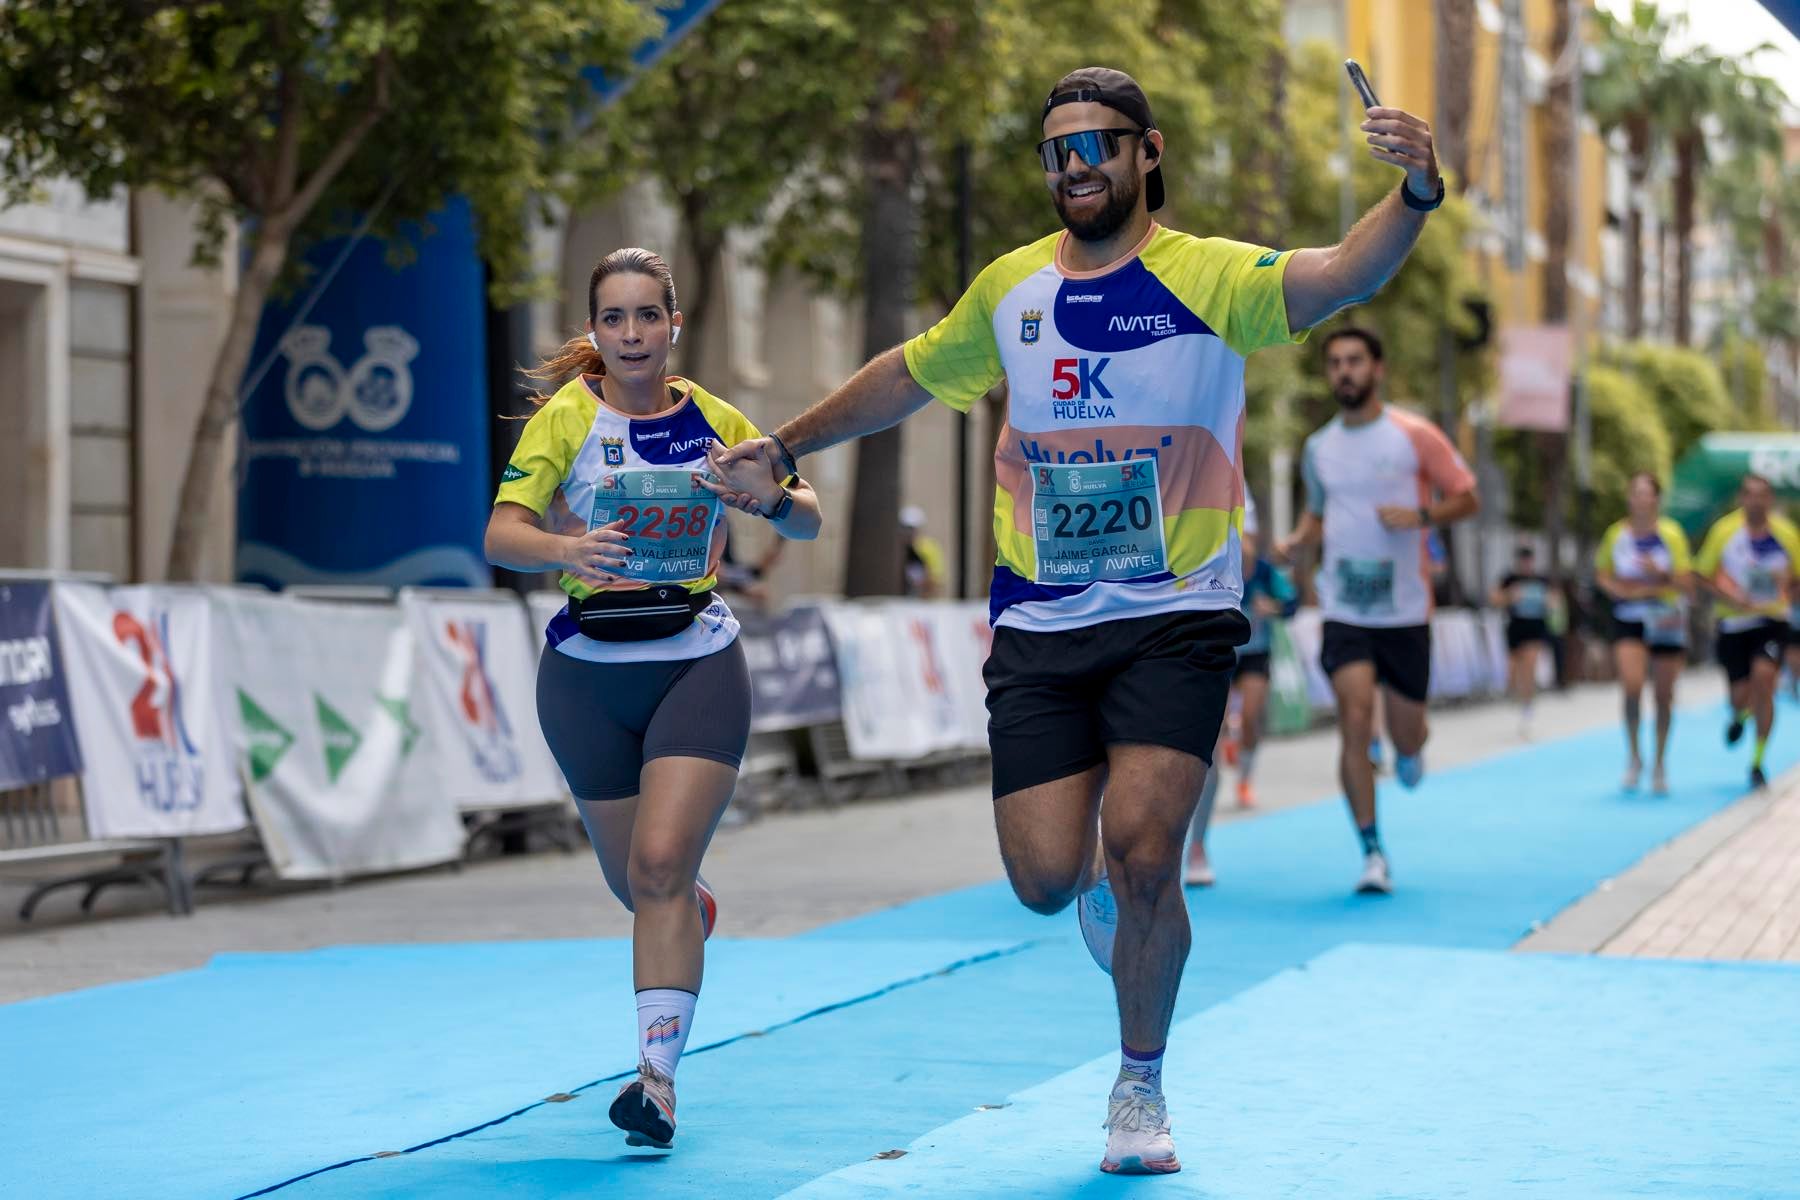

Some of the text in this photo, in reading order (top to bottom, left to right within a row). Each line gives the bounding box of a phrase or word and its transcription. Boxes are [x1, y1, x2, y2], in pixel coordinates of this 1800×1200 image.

[1108, 313, 1176, 331] AVATEL
[1052, 358, 1114, 400] 5K
[1053, 405, 1116, 419] HUELVA
[669, 436, 713, 454] AVATE
[1121, 463, 1147, 481] 5K
[616, 505, 709, 539] 2258
[1052, 495, 1152, 538] 2220
[641, 546, 707, 559] VALLELLANO
[1055, 543, 1140, 560] JAIME GARCIA
[658, 559, 702, 573] AVATEL
[1043, 554, 1159, 575] Huelva AVATEL
